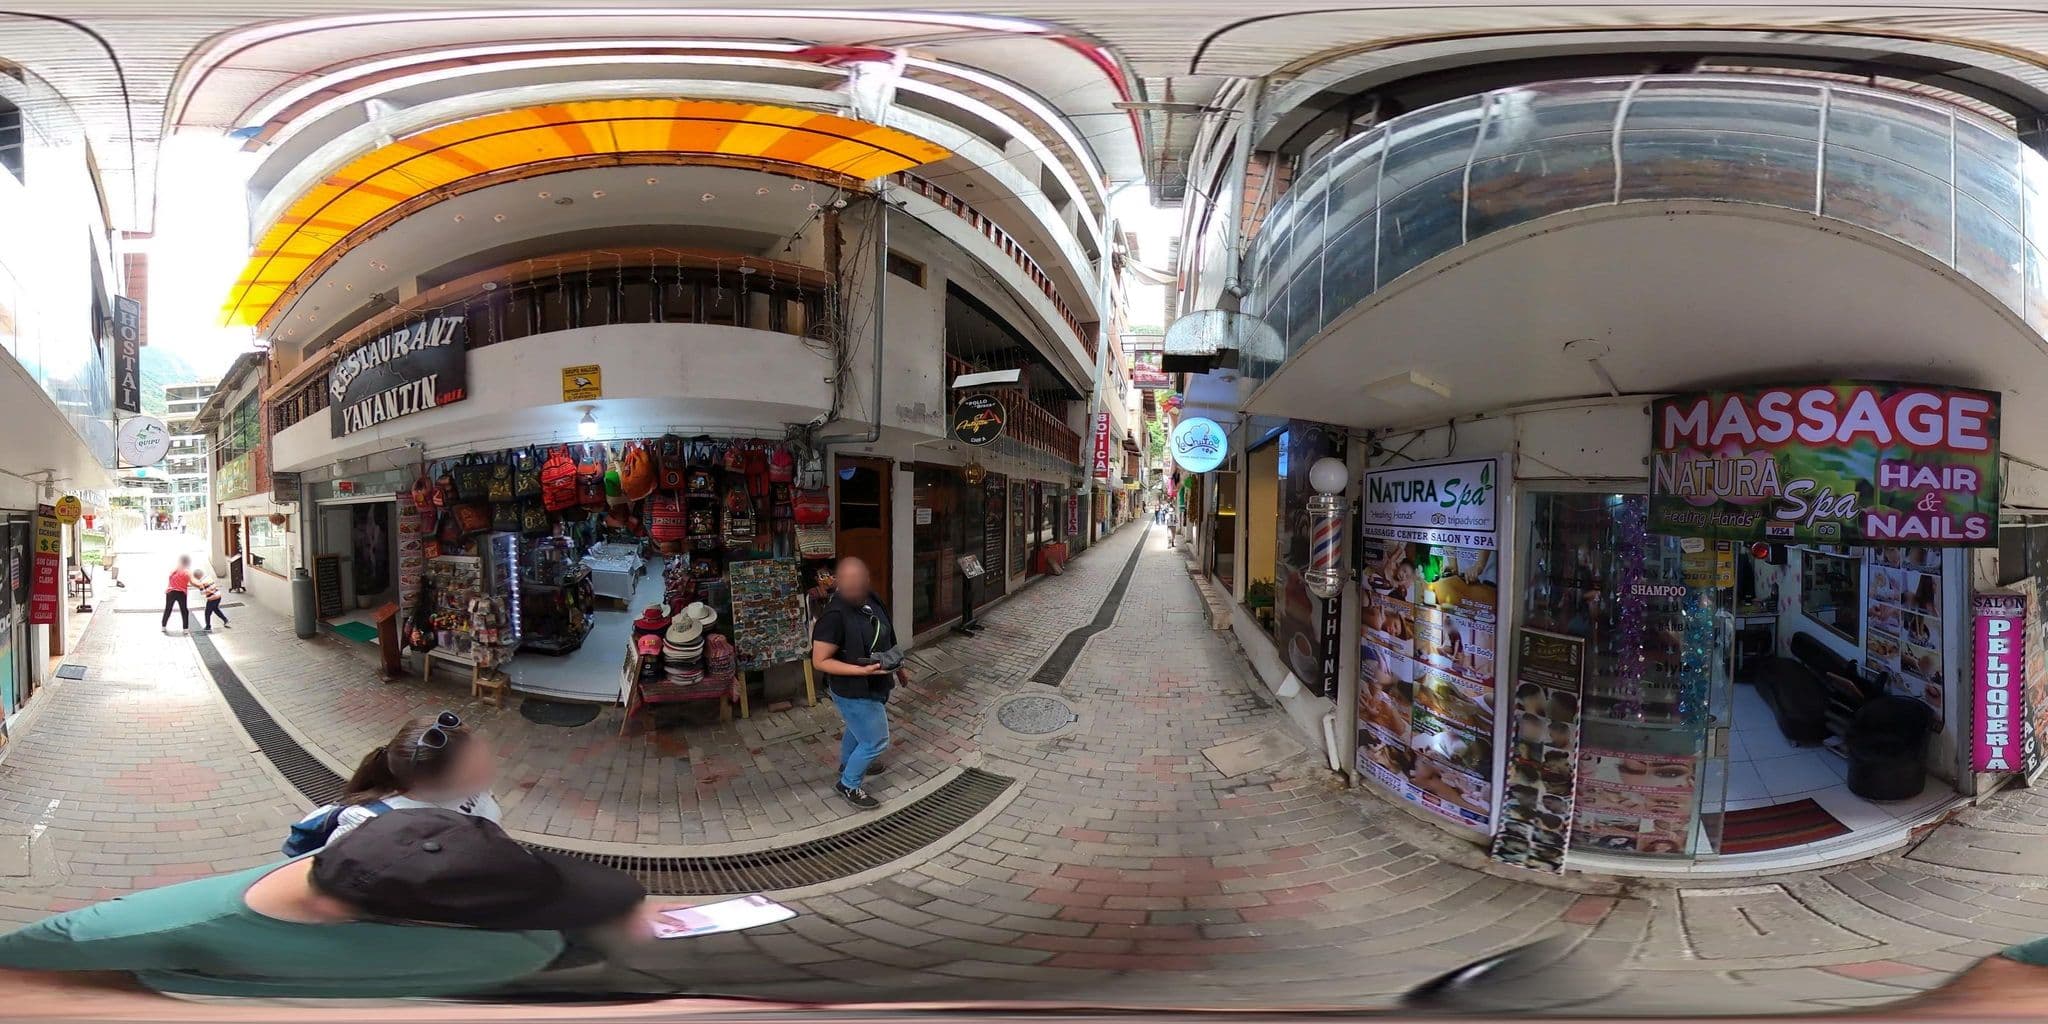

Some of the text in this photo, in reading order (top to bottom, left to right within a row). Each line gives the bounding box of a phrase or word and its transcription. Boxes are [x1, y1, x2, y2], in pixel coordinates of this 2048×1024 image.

[120, 311, 137, 412] HOSTAL
[331, 316, 464, 403] RESTAURANT
[342, 374, 438, 435] YANANTIN
[1664, 389, 1989, 451] MASSAGE
[1096, 414, 1108, 469] BOTICA
[1369, 476, 1487, 514] NATURA Spa
[1653, 453, 1863, 528] NATURA Spa
[1880, 463, 1977, 491] HAIR
[1917, 492, 1942, 513] &
[1365, 527, 1495, 547] MASSAGE CENTER SALON Y SPA
[1771, 528, 1790, 536] VISA
[1867, 514, 1986, 539] NAILS
[1631, 584, 1687, 597] SHAMPOO
[1974, 597, 2025, 609] SALON
[1986, 619, 2011, 770] PELUQUERIA
